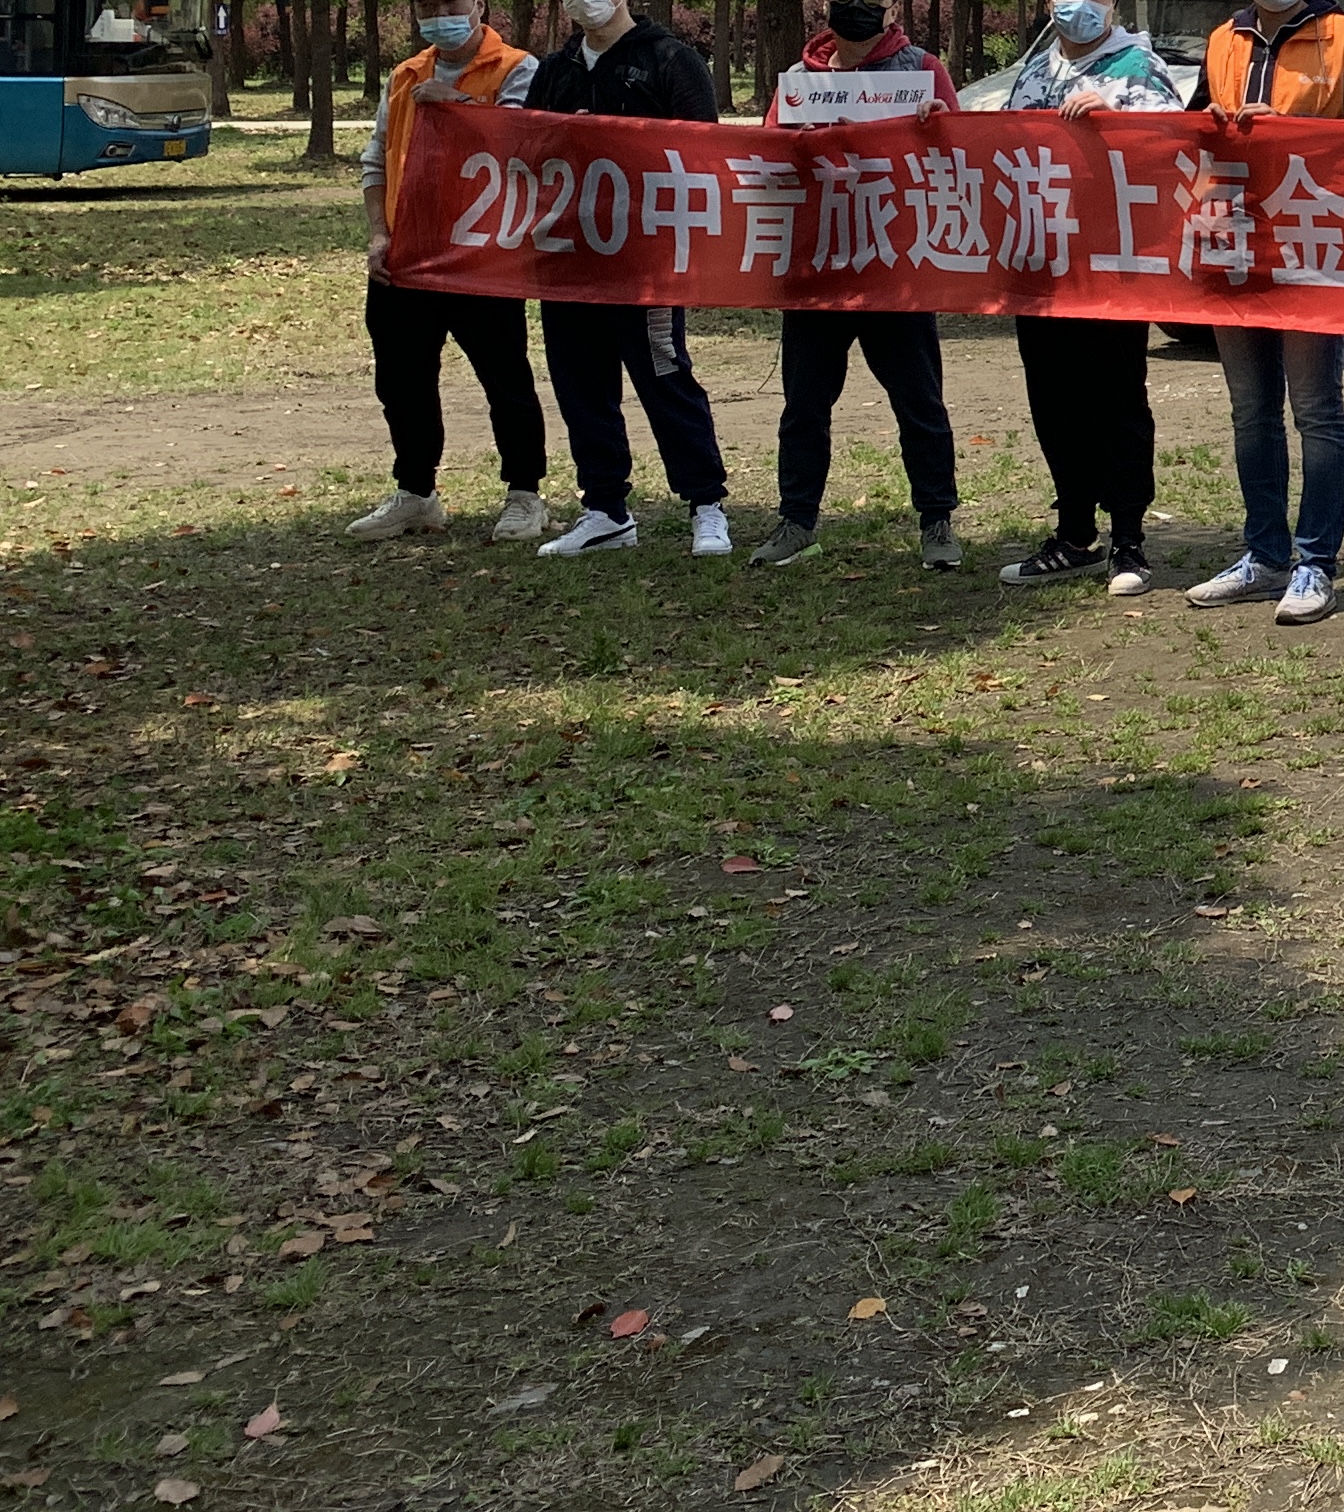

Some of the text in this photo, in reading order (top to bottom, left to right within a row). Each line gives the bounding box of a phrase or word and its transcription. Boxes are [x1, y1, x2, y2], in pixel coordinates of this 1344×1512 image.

[808, 88, 927, 104] 中青旅 AoYou 遨游
